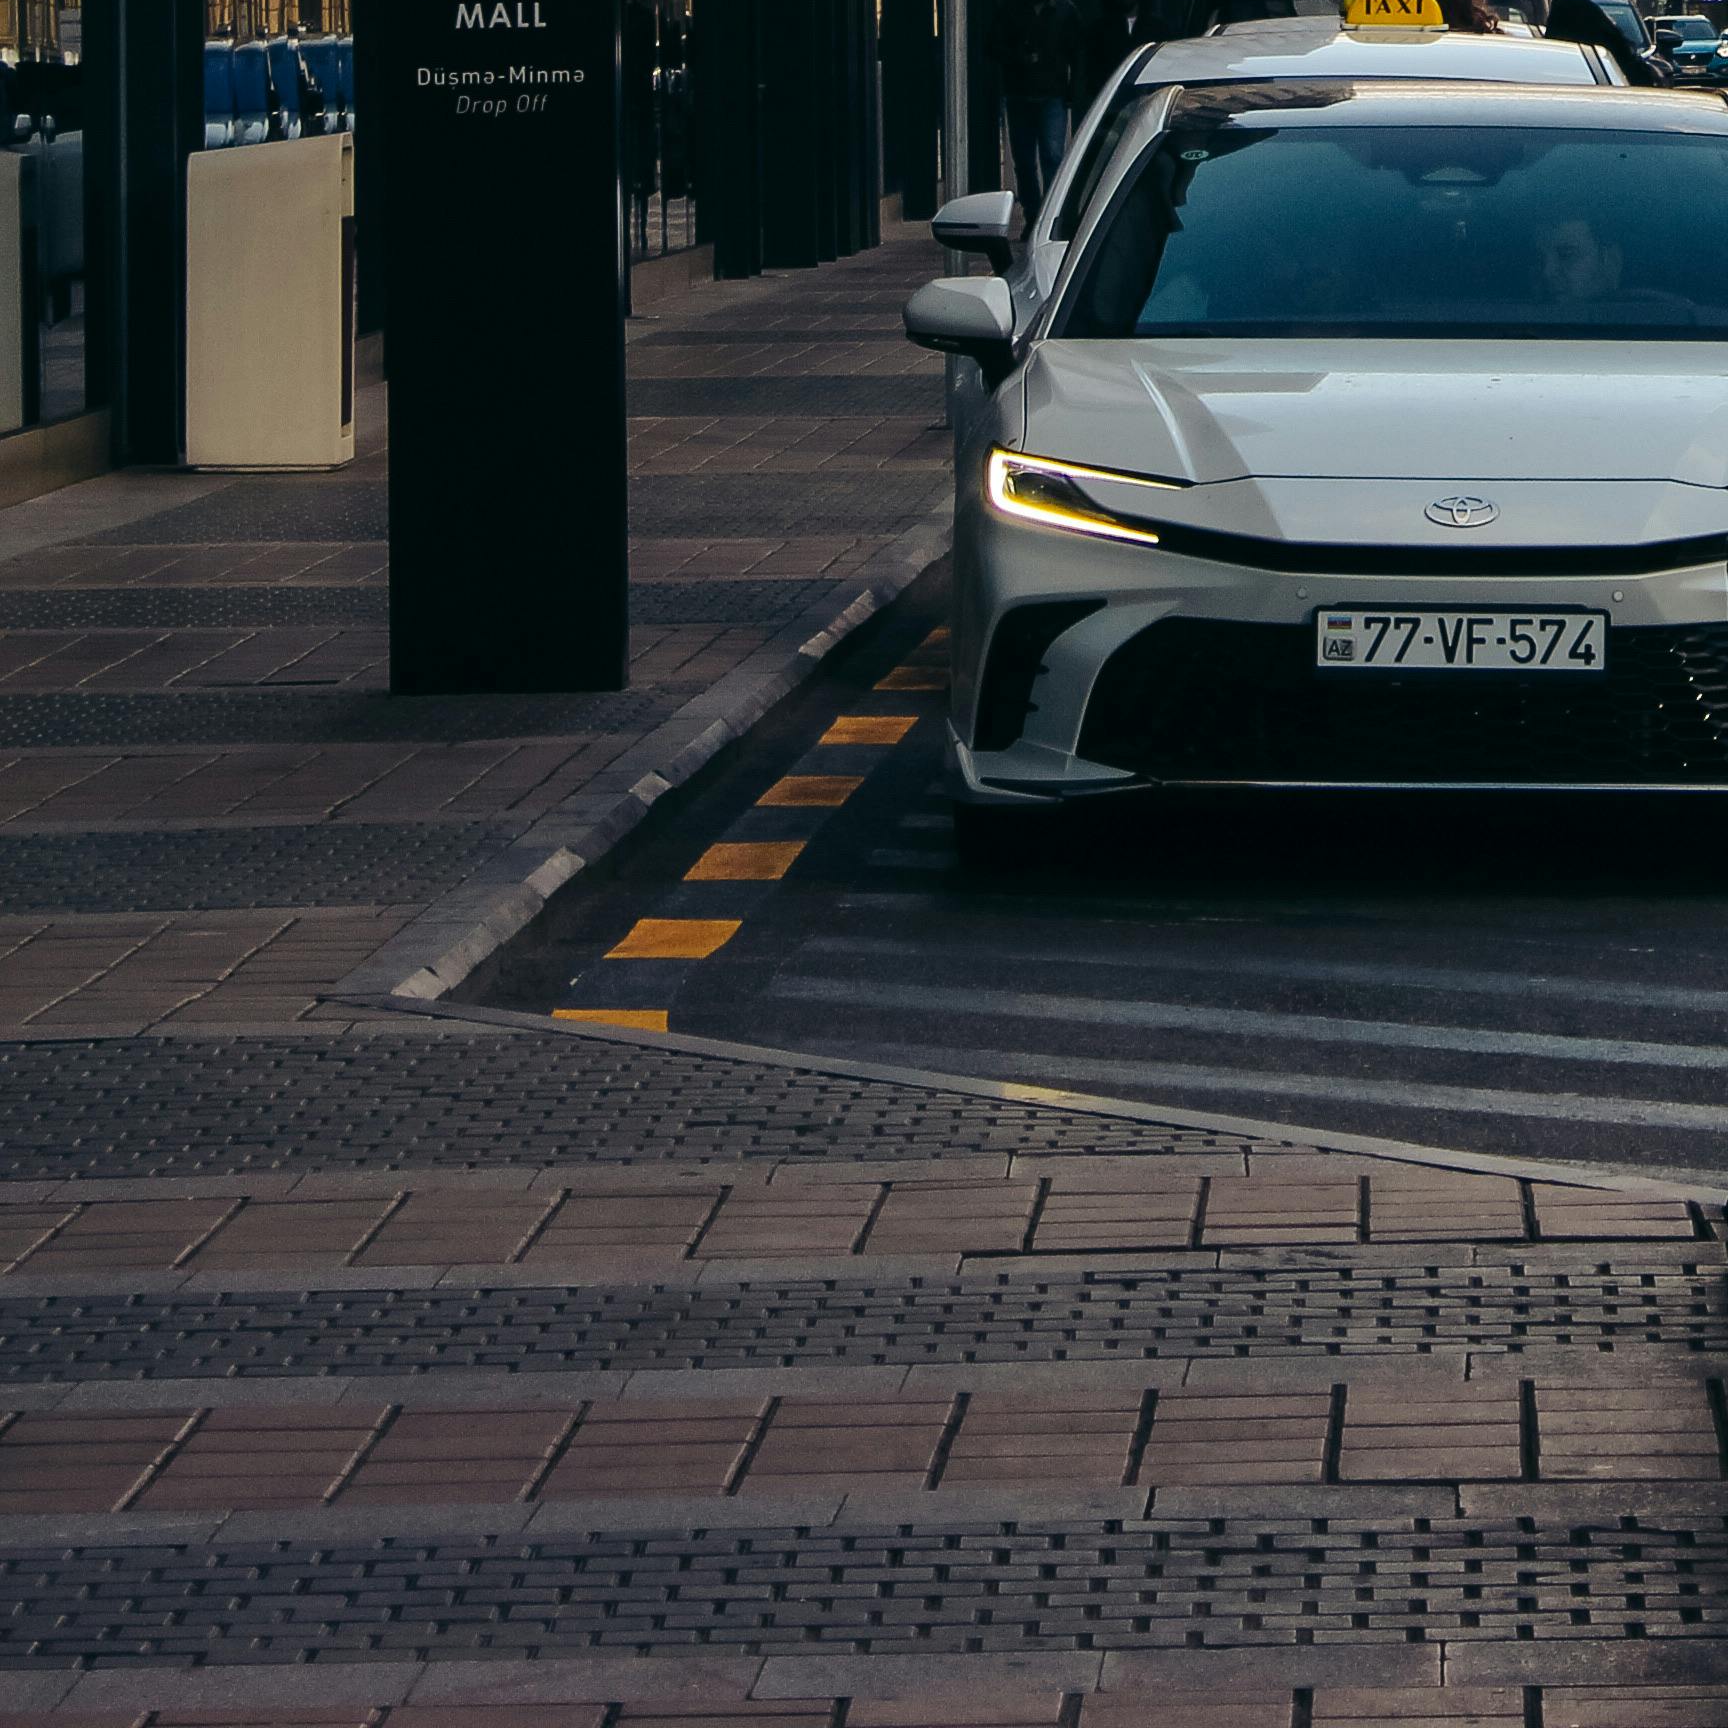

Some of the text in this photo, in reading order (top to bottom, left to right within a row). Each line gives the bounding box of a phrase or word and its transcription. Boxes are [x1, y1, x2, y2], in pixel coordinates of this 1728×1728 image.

[455, 1, 547, 29] MALL
[455, 94, 549, 117] Drop Off
[1327, 638, 1352, 657] AZ
[1363, 616, 1597, 666] 77-VF-574
